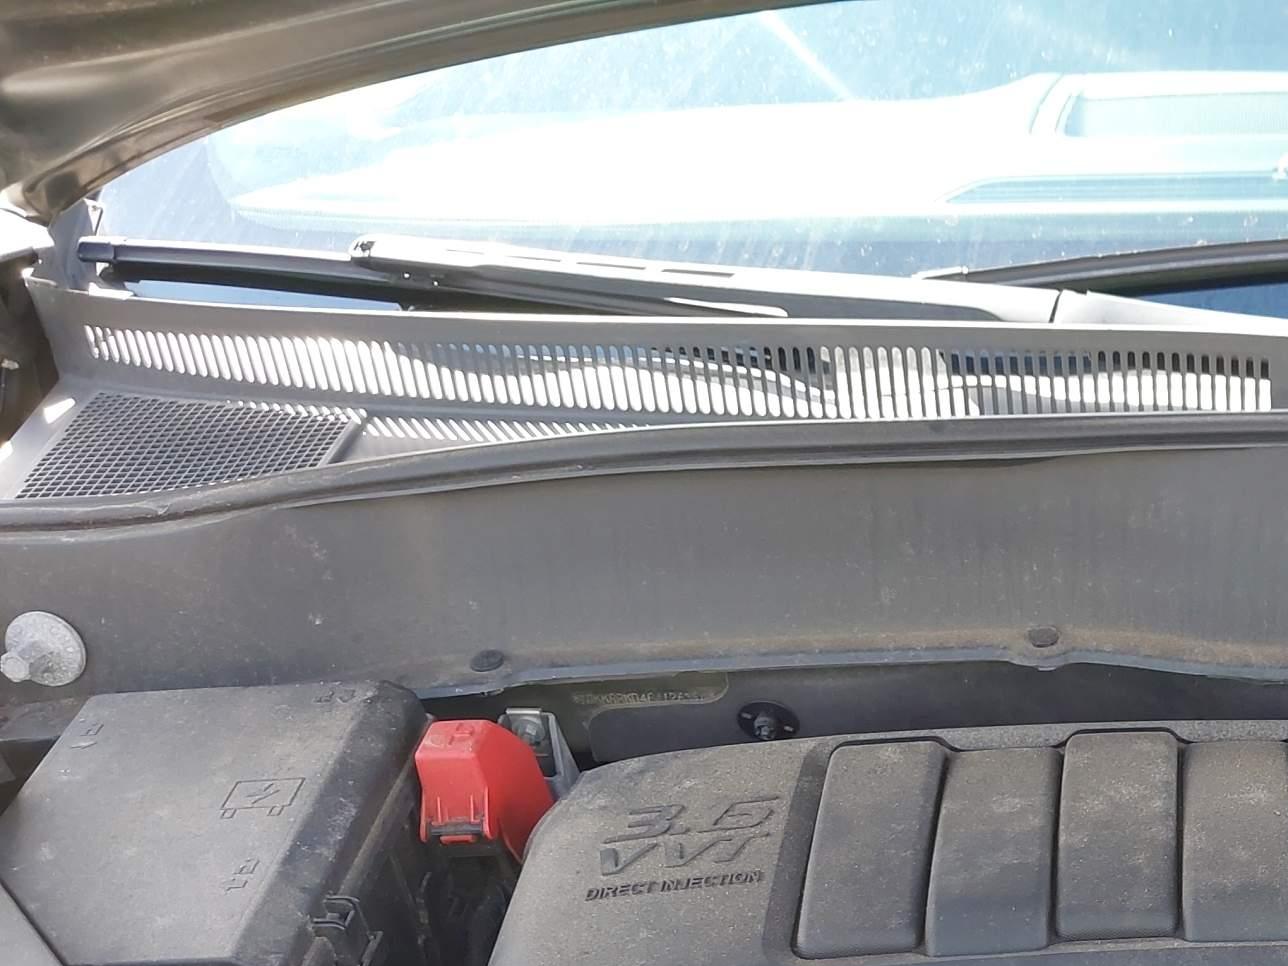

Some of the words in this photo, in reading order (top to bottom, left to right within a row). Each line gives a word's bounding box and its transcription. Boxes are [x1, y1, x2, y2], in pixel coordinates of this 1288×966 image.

[599, 832, 770, 877] VVT
[585, 881, 656, 902] DIRECT
[661, 871, 763, 893] INJECTION
